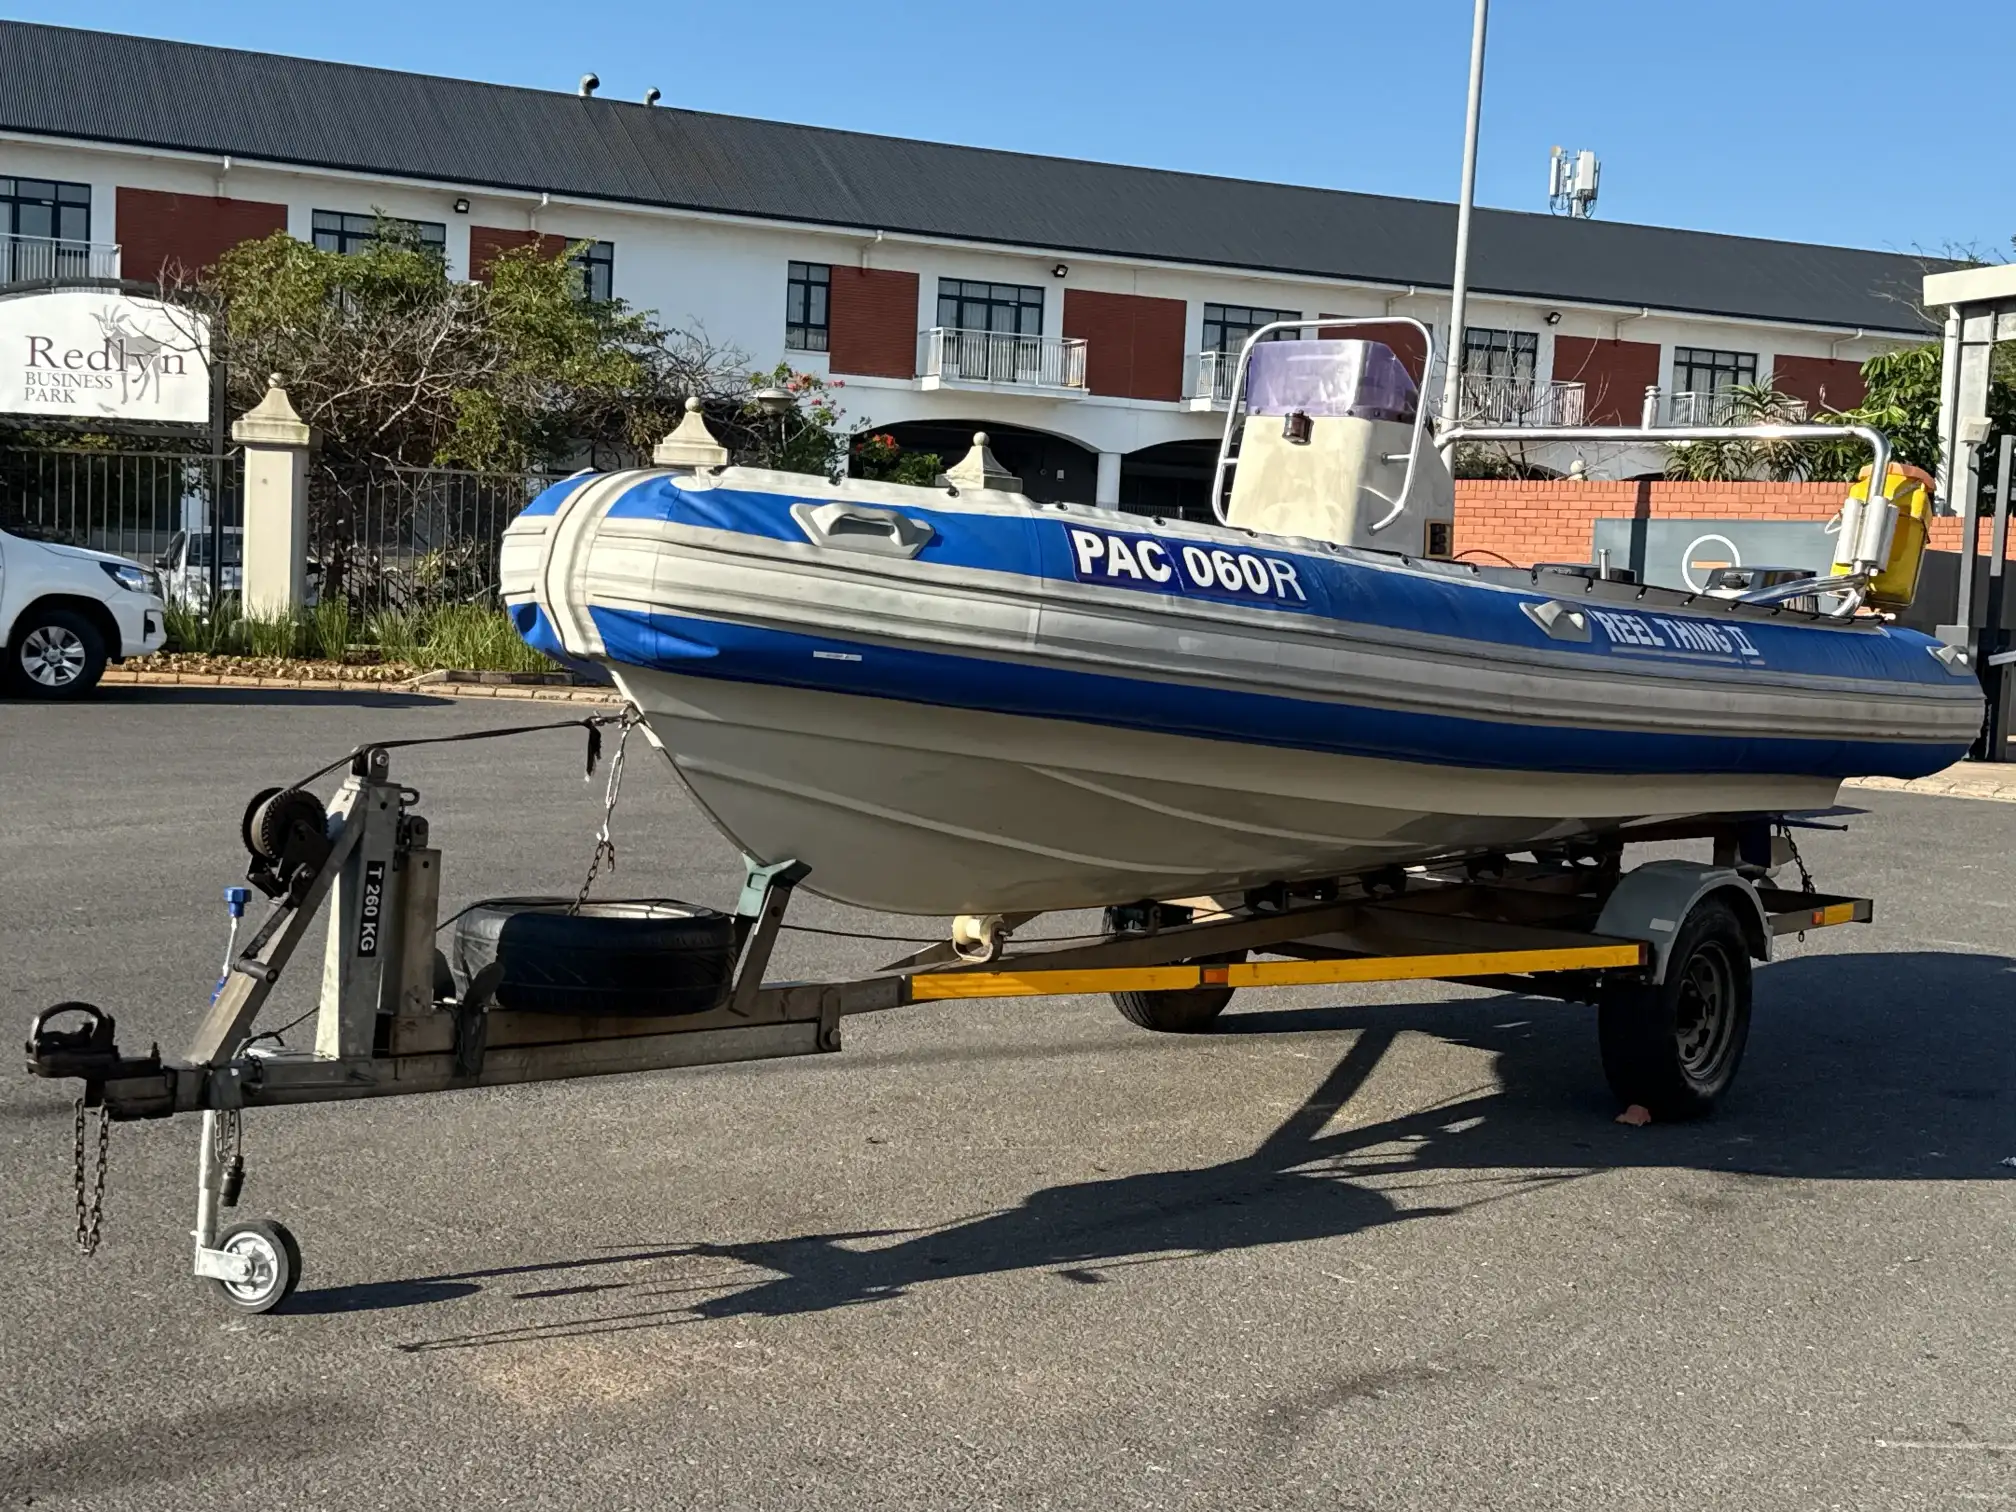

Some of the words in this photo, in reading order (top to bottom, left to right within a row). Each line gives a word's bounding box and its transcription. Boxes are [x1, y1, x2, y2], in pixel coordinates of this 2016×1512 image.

[25, 335, 187, 383] Redlyn
[25, 371, 113, 389] BUSINESS
[25, 387, 76, 404] PARK
[1071, 529, 1172, 582] PAC
[1182, 546, 1307, 600] 060R
[1652, 617, 1732, 653] THING
[1721, 625, 1760, 656] II
[368, 866, 383, 879] T
[365, 884, 381, 916] 260
[361, 922, 377, 951] KG
